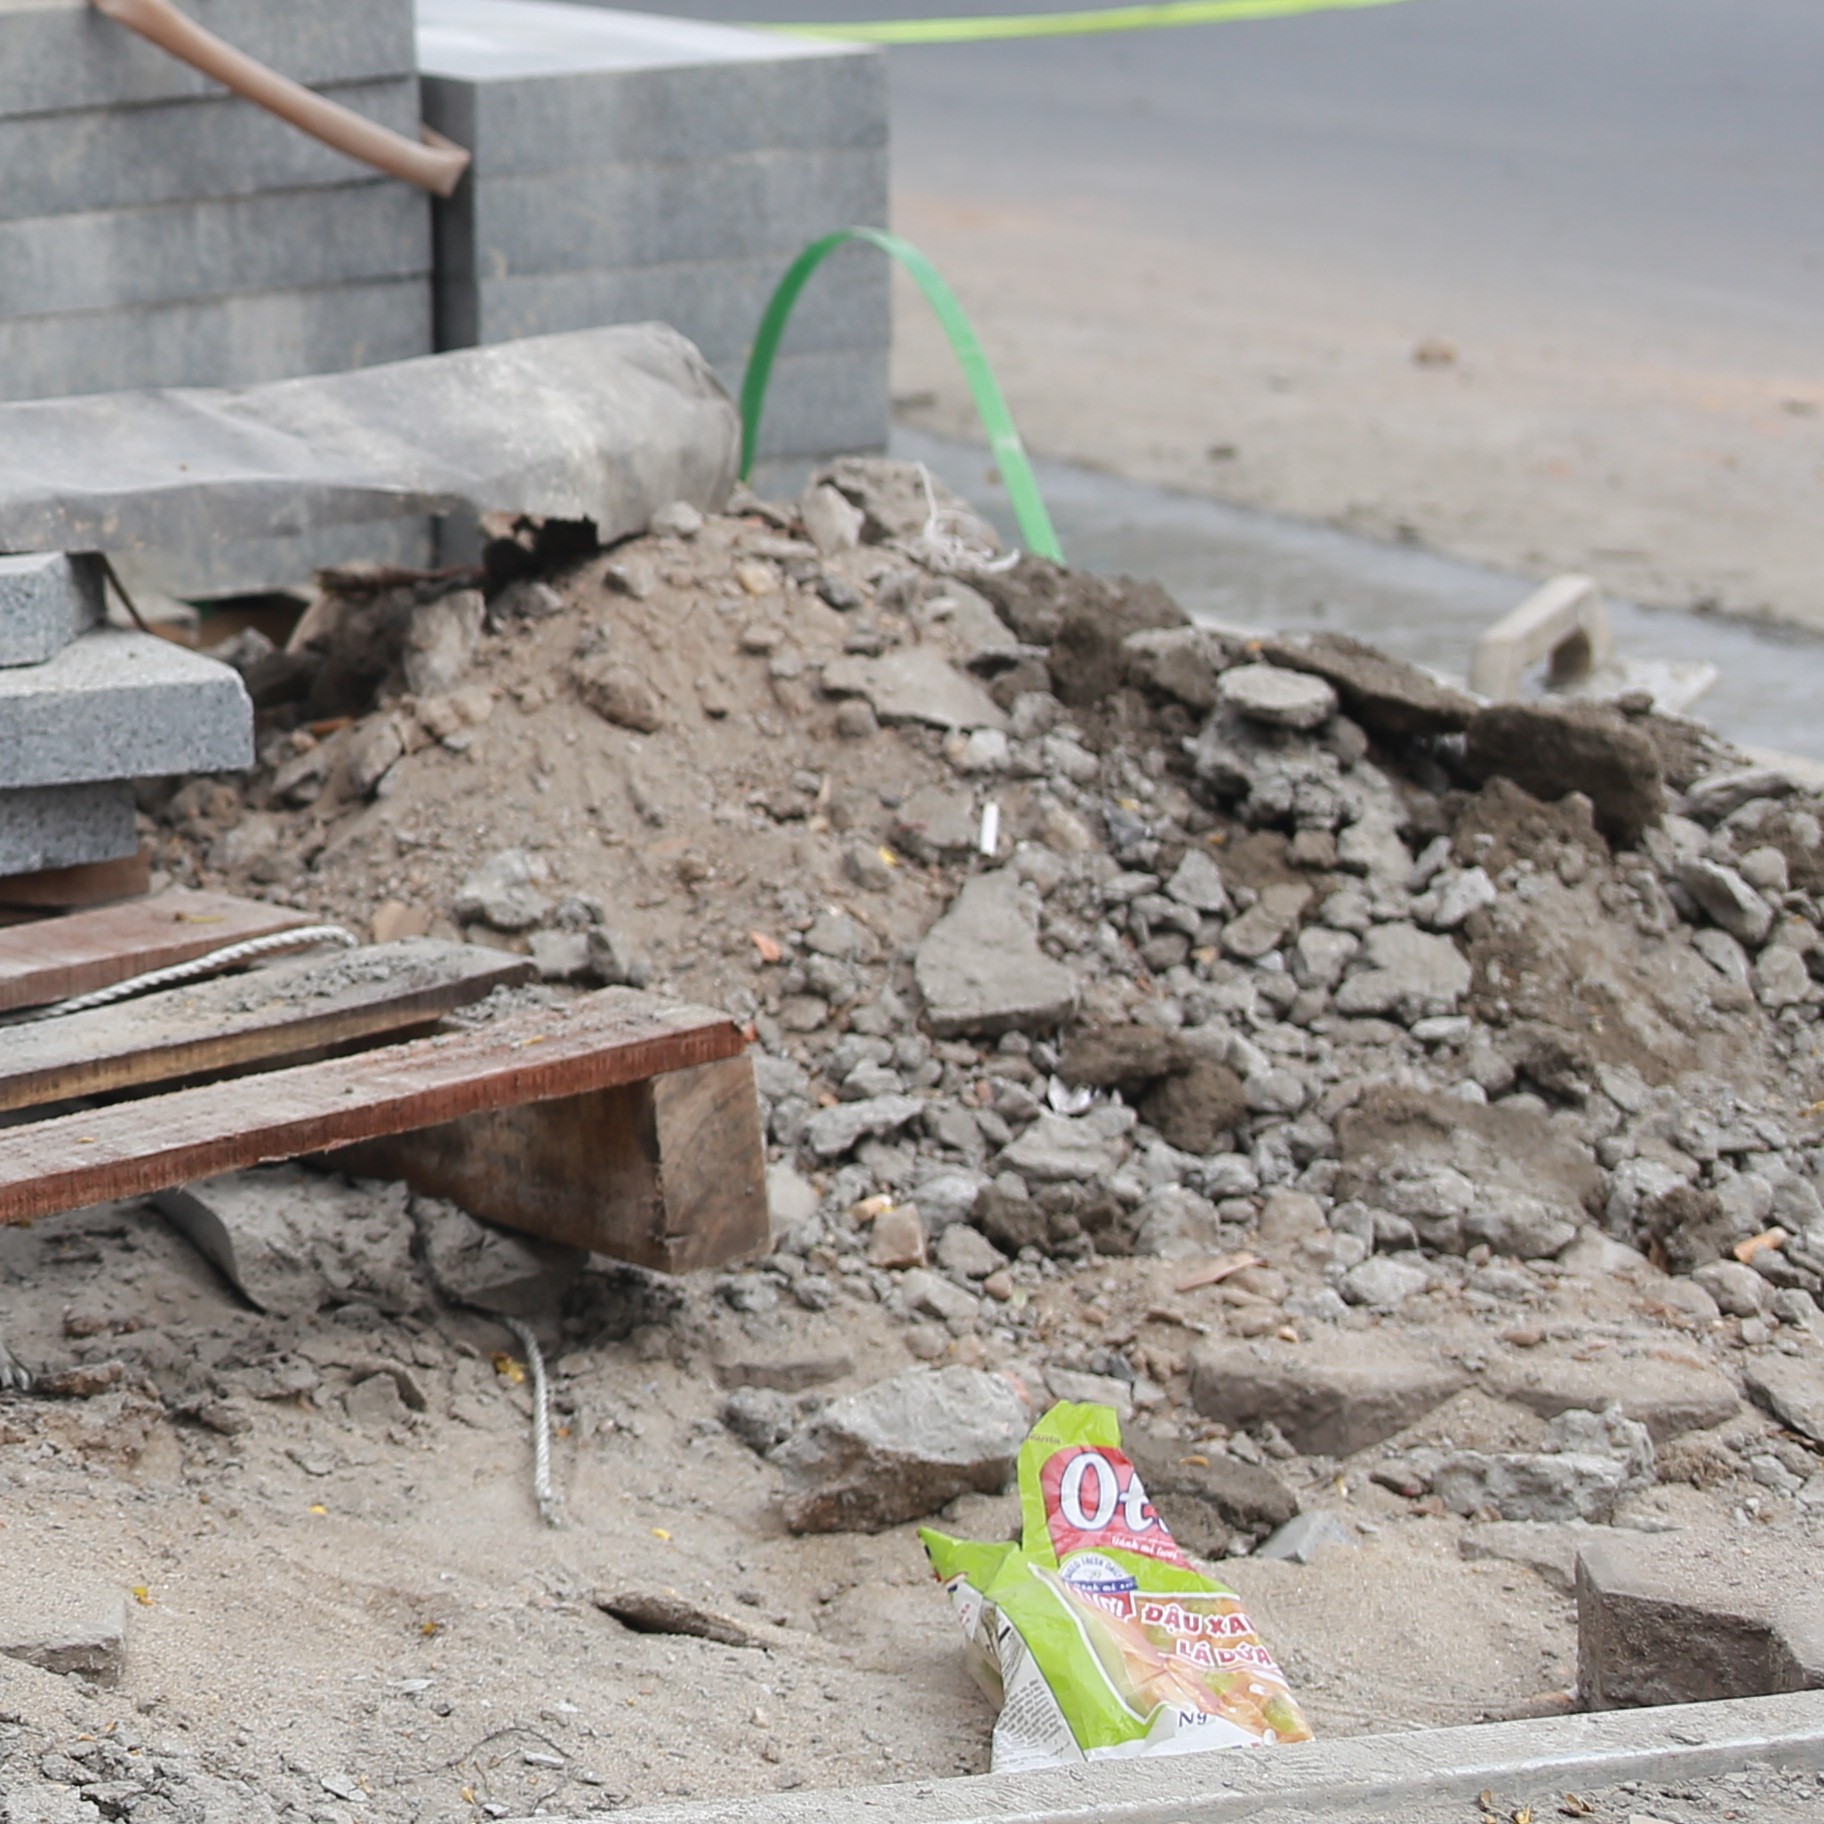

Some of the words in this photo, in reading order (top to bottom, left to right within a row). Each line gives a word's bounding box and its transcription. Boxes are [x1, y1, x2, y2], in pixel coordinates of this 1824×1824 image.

[1060, 1451, 1171, 1534] Ot
[1143, 1604, 1200, 1634] ĐẬU
[1178, 1639, 1212, 1666] LÁ
